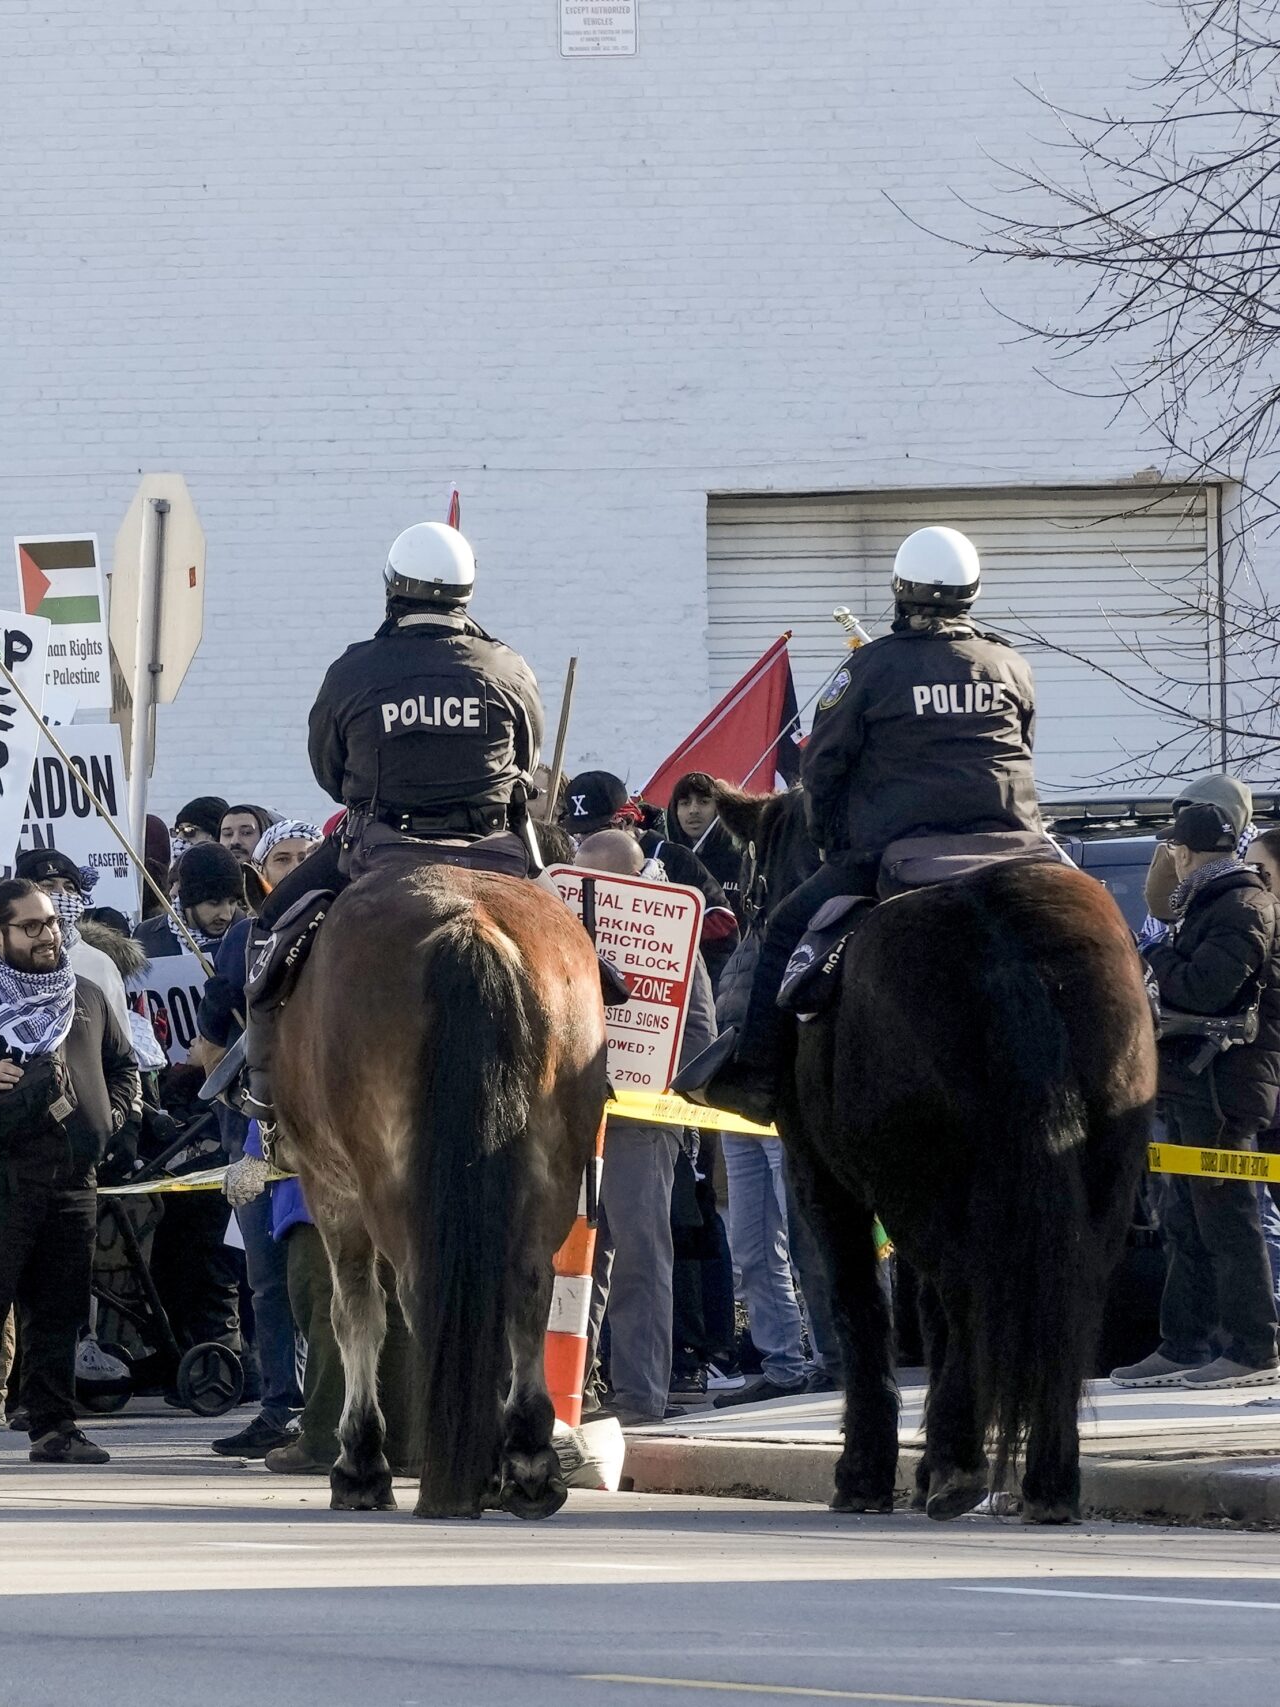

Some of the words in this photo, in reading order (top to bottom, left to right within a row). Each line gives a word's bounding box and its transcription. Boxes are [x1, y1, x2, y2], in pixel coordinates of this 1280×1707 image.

[69, 637, 103, 661] Rights
[53, 667, 101, 686] Palestine
[912, 682, 1008, 716] POLICE
[381, 695, 480, 733] POLICE
[23, 755, 118, 820] NDON
[571, 795, 588, 816] X
[88, 853, 129, 868] CEASEFIRE
[113, 867, 128, 879] NOW
[631, 898, 689, 921] EVENT
[577, 912, 656, 936] RKING
[595, 930, 674, 955] TRICTION
[624, 953, 680, 973] BLOCK
[630, 976, 674, 1003] ZONE
[604, 1006, 632, 1023] STED
[636, 1012, 670, 1030] SIGNS
[607, 1038, 645, 1054] OWED
[614, 1069, 651, 1085] 2700
